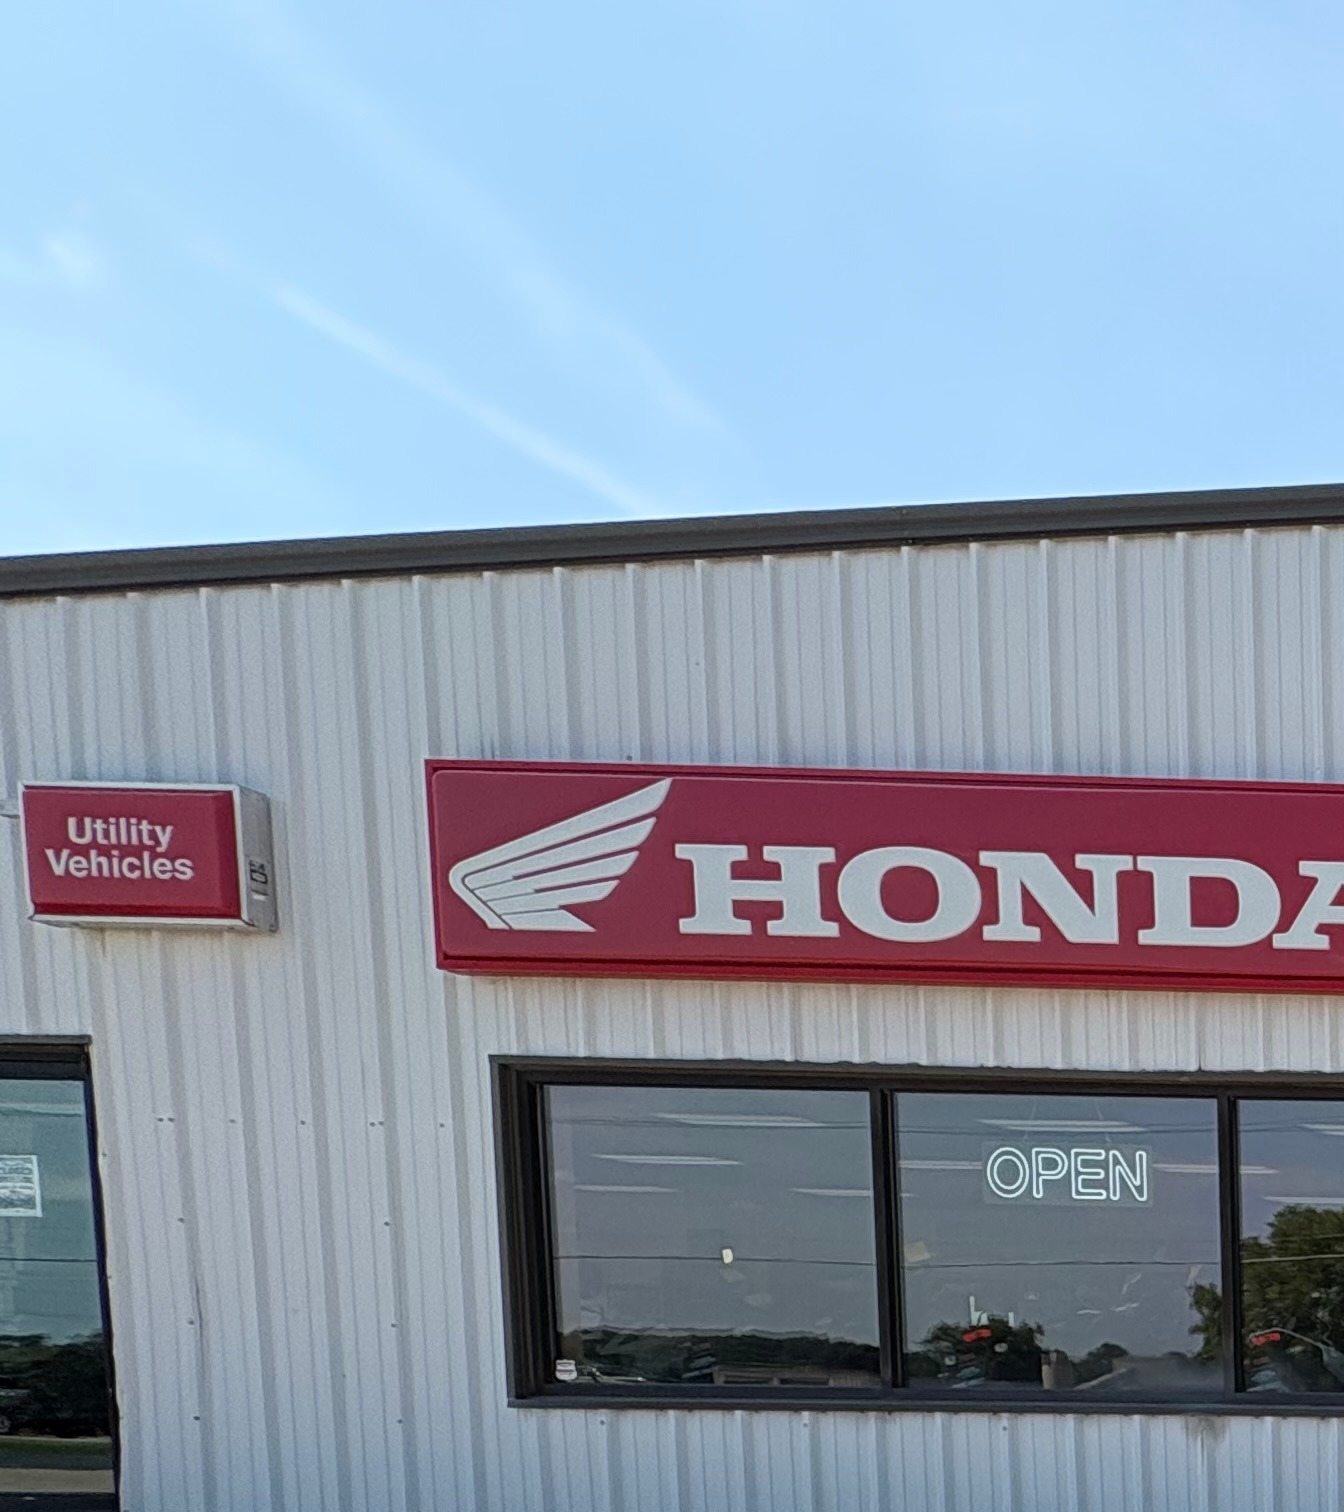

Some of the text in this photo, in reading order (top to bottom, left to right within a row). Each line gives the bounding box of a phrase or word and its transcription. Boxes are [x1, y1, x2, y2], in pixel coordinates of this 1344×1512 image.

[67, 816, 174, 853] Utility
[44, 848, 195, 880] Vehicles
[986, 1147, 1148, 1201] OPEN
